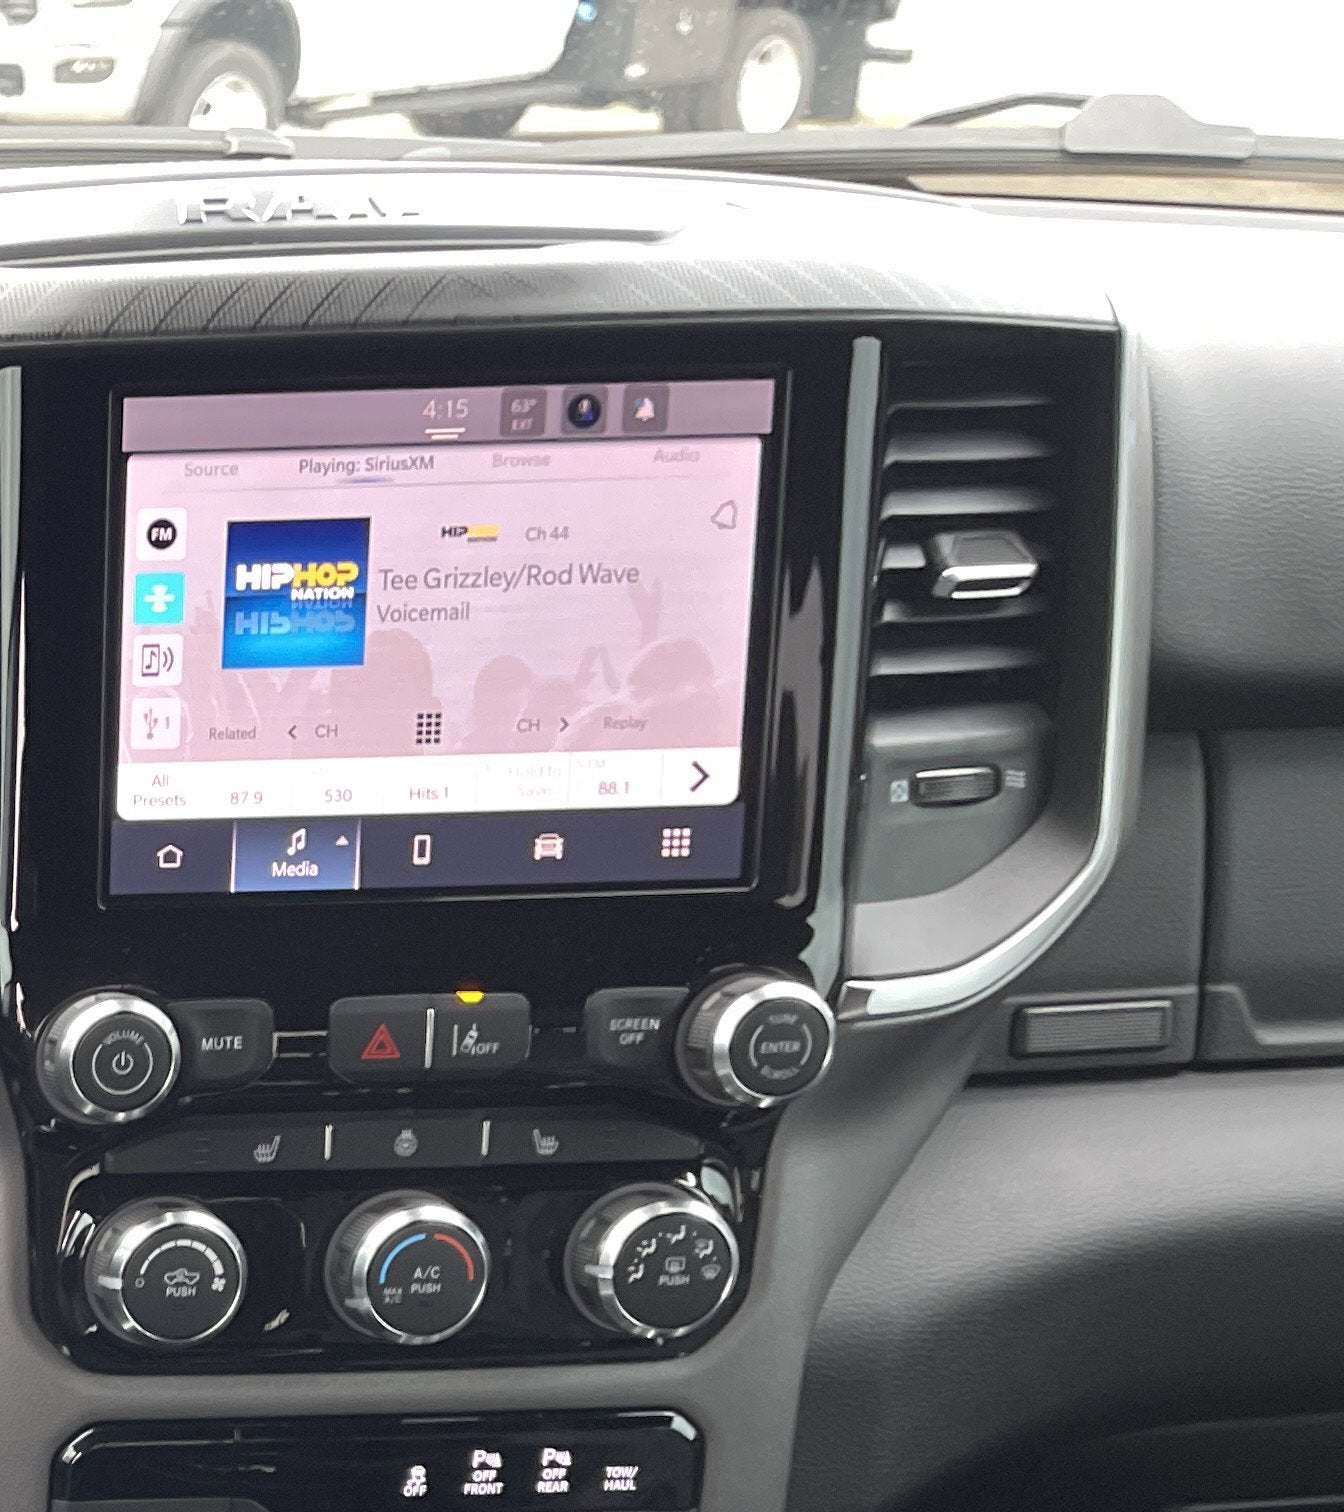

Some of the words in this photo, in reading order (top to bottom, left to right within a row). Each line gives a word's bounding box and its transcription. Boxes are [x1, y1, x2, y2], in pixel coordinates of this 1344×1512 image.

[422, 399, 469, 420] 4:15
[492, 453, 552, 468] Browse
[653, 448, 701, 463] Audio
[184, 463, 239, 477] Source
[299, 458, 360, 476] Playing:
[364, 455, 434, 472] SiriusXM
[151, 528, 173, 541] FM
[525, 526, 546, 542] Ch
[549, 526, 569, 541] 44
[378, 569, 418, 591] Tee
[422, 563, 573, 593] Grizzley/Rod
[578, 563, 640, 587] Wave
[290, 585, 354, 601] NATION
[377, 602, 471, 623] Voicemail
[315, 724, 339, 739] CH
[516, 718, 541, 734] CH
[603, 715, 650, 733] Replay
[208, 726, 257, 741] Related
[152, 774, 170, 788] All
[597, 780, 630, 796] 88.1
[133, 793, 187, 808] Presets
[324, 788, 353, 803] 530
[409, 786, 438, 801] Hits
[271, 861, 320, 877] Media
[609, 1016, 661, 1032] SCREEN
[102, 1028, 145, 1047] VOLUME
[200, 1035, 243, 1051] MUTE
[619, 1031, 644, 1046] OFF
[475, 1041, 501, 1055] OFF
[760, 1040, 802, 1055] ENTER
[413, 1265, 442, 1280] A/C
[165, 1286, 197, 1298] PUSH
[410, 1282, 442, 1295] PUSH
[472, 1469, 498, 1482] OFF
[541, 1467, 567, 1481] OFF
[402, 1484, 428, 1497] OFF
[463, 1481, 505, 1496] FRONT
[535, 1480, 570, 1493] REAR
[602, 1479, 637, 1492] HAUL
